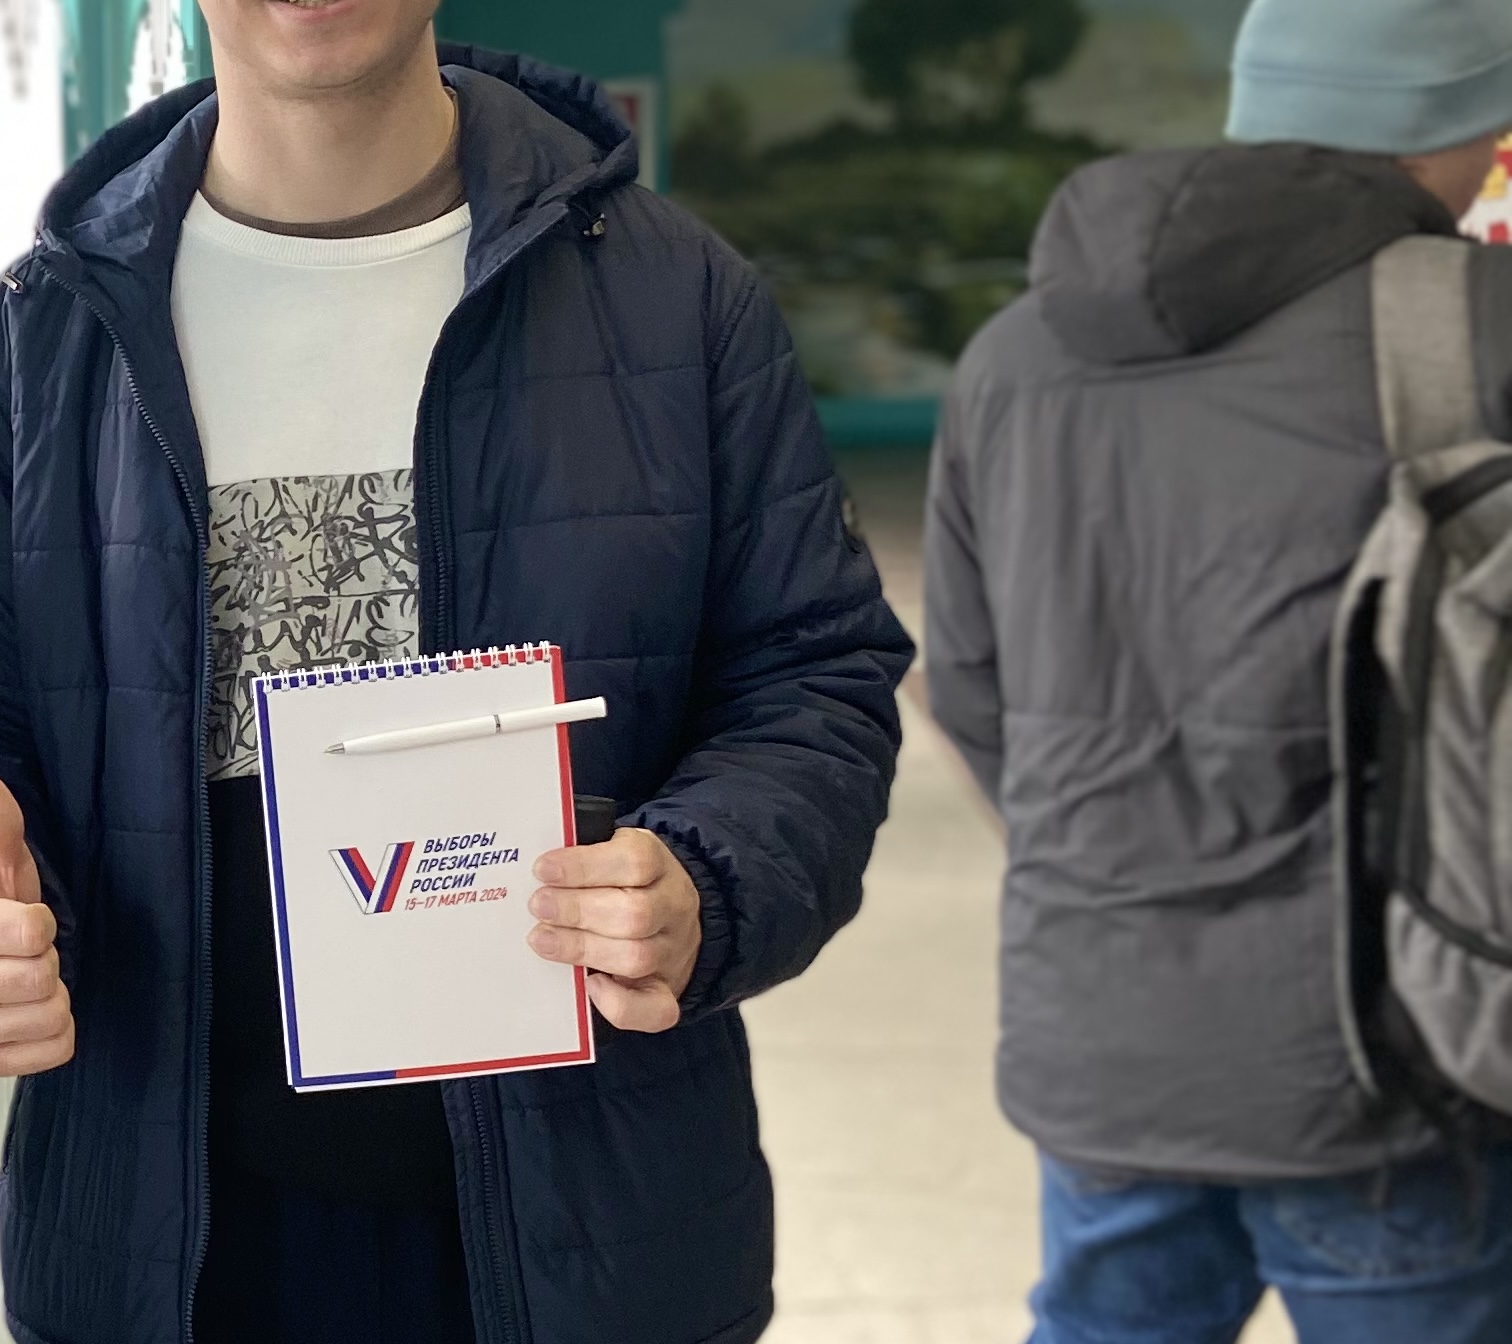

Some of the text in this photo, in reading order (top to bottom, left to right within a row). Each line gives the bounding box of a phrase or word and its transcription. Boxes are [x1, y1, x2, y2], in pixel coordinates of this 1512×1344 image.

[423, 832, 497, 853] ВЫБОРЫ
[416, 848, 520, 874] ПРЕЗИДЕНТА
[410, 873, 476, 893] РОССИИ
[438, 889, 477, 908] МАРТА
[479, 887, 508, 902] 2024
